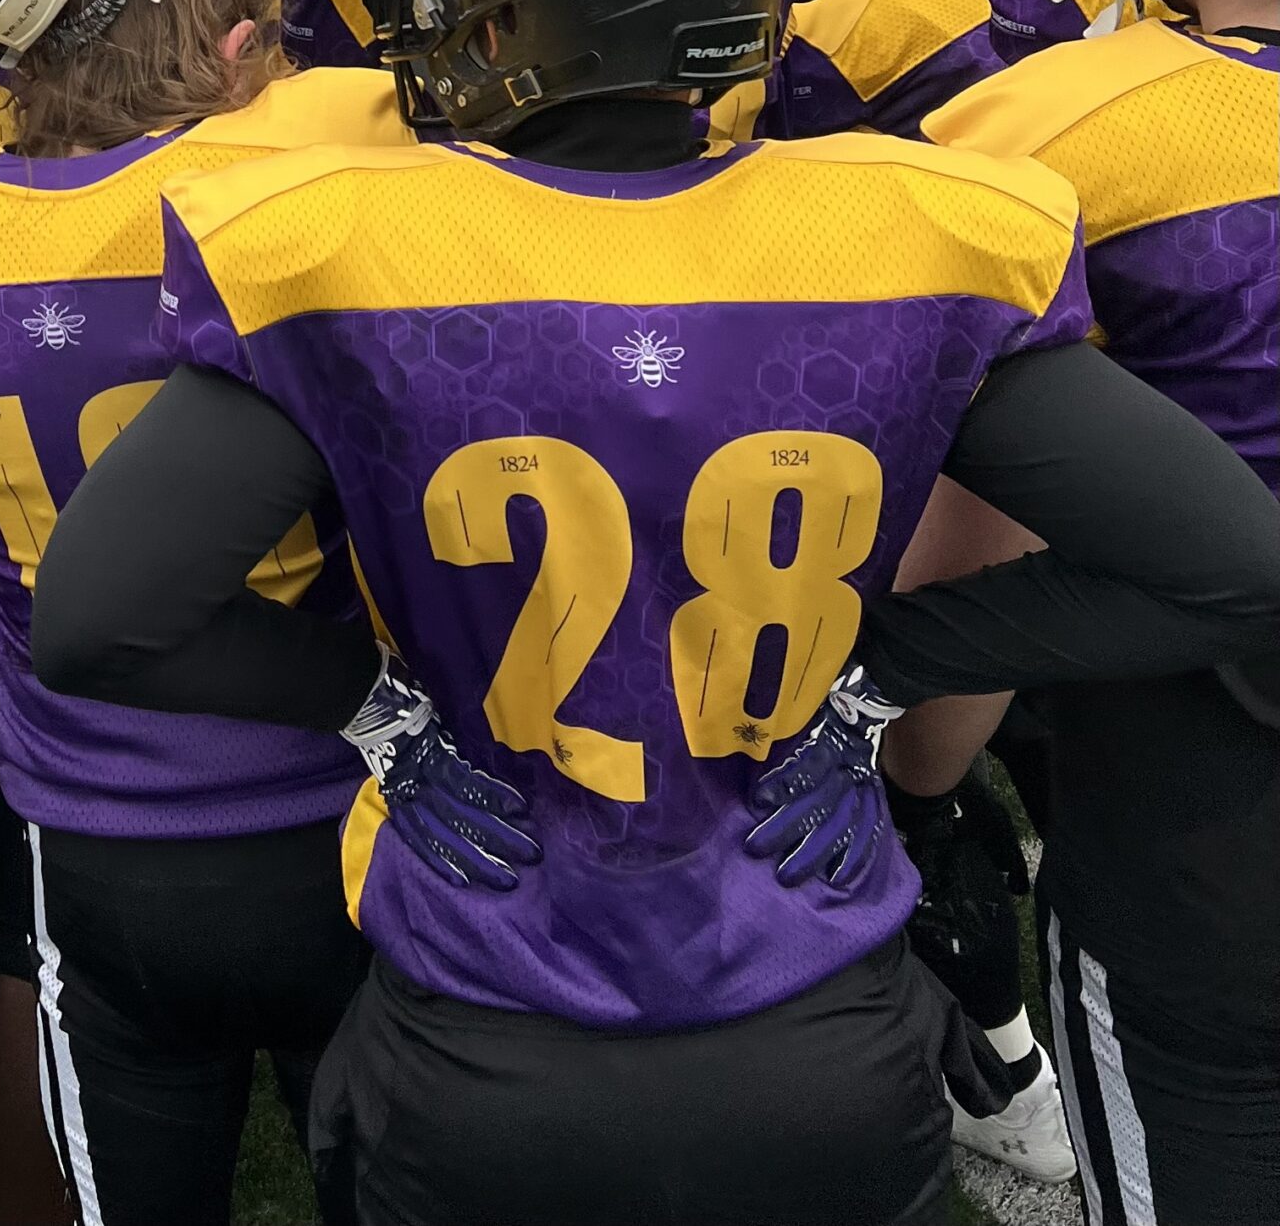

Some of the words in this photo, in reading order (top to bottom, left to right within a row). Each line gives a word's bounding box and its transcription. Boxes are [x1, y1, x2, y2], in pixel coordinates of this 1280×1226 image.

[498, 454, 540, 473] 1824
[769, 448, 811, 467] 1824
[423, 430, 884, 803] 28
